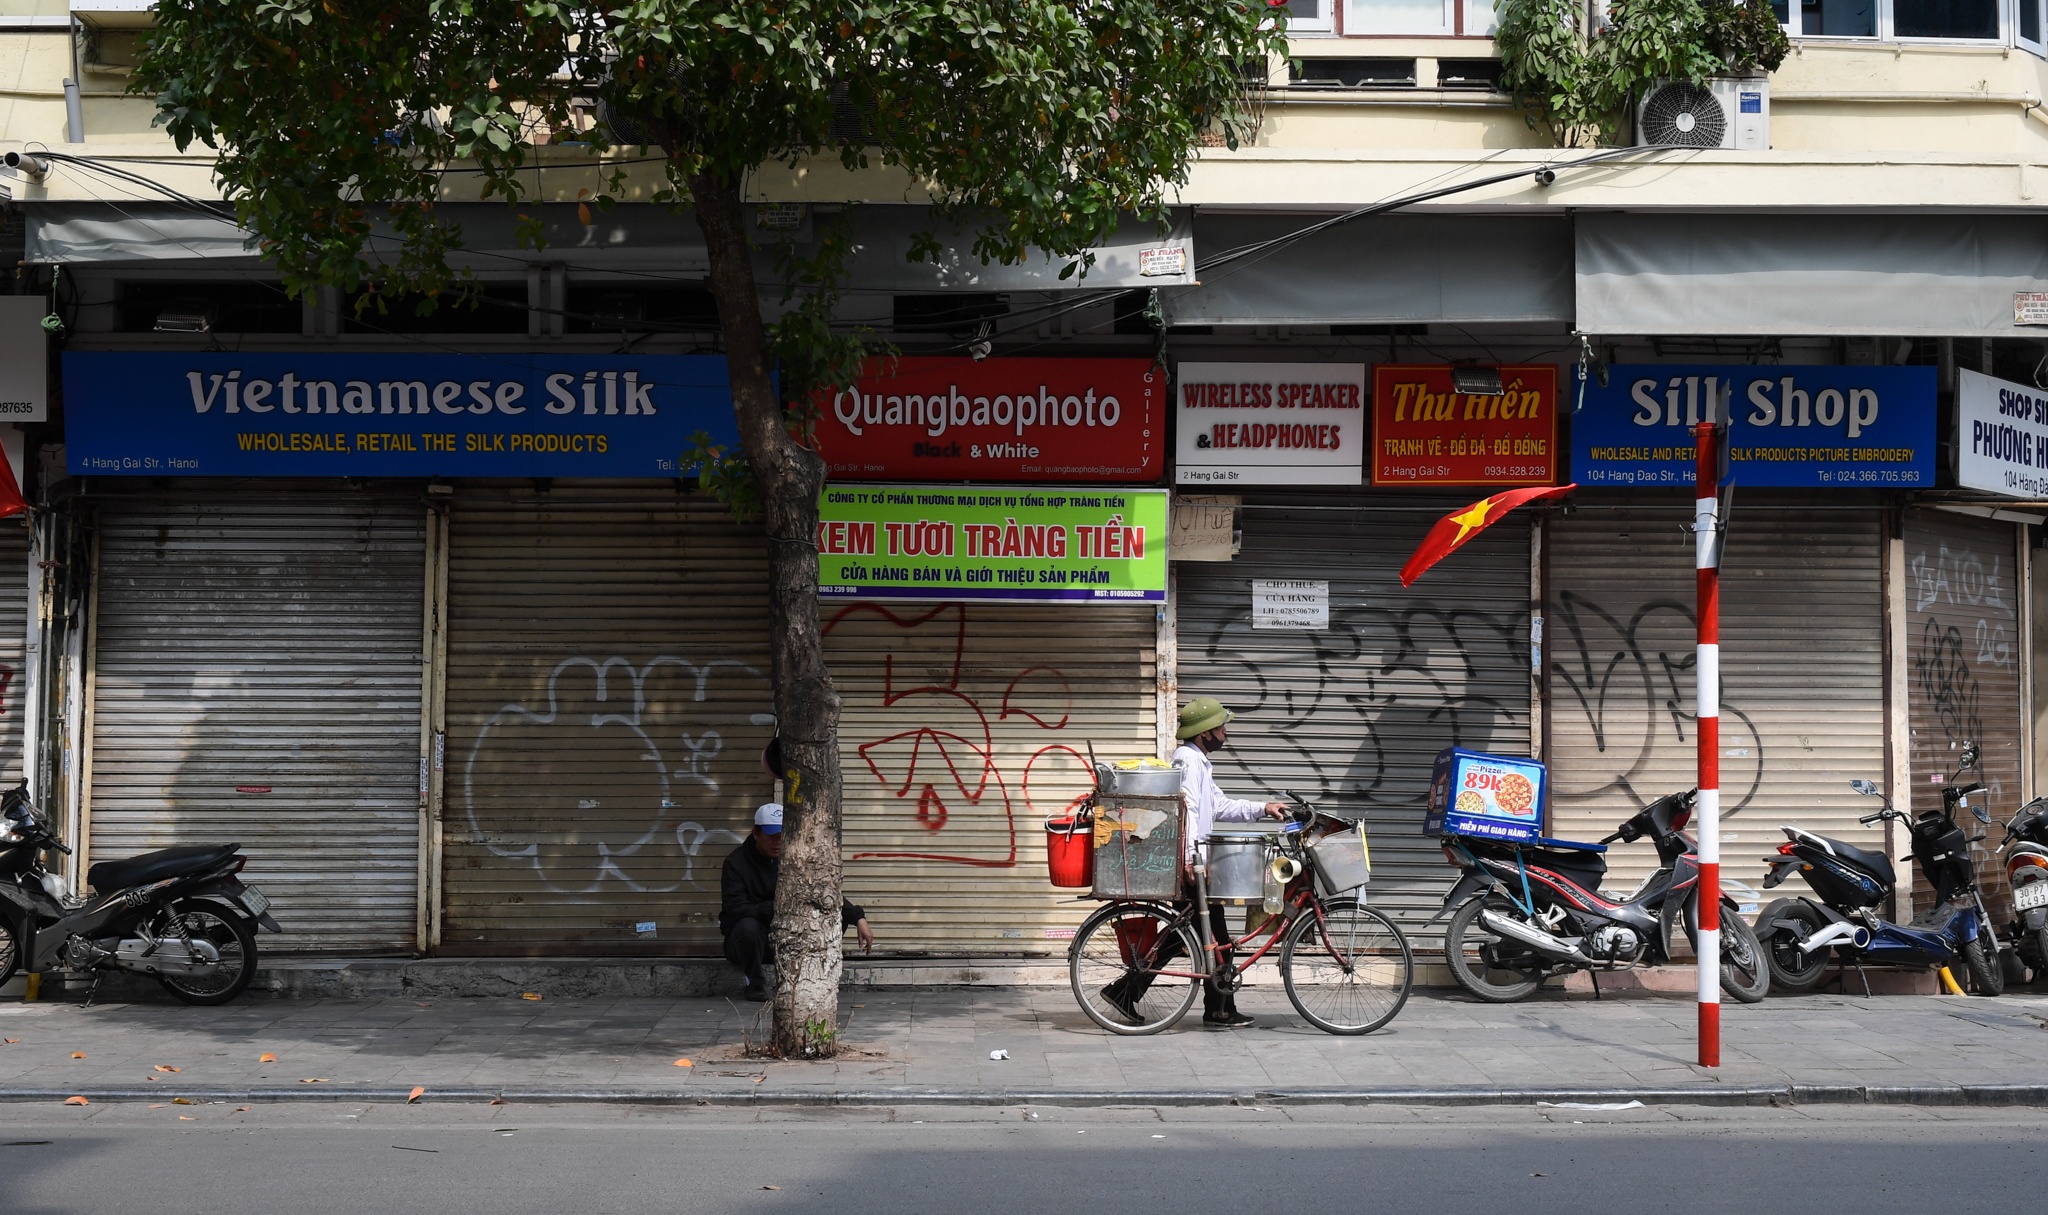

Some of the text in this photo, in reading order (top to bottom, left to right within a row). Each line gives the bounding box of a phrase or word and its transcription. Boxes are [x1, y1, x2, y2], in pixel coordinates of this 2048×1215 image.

[186, 371, 656, 415] Vietnamese Silk
[1184, 383, 1360, 409] WIRELESS SPEAKER
[1393, 377, 1540, 422] Thu Hiền
[0, 402, 33, 414] 87635
[834, 385, 1120, 436] Quangbaophoto
[1748, 377, 1880, 437] Shop
[1999, 388, 2031, 420] SHOP
[1142, 372, 1154, 467] Gallery
[238, 432, 608, 454] WHOLESALE, RETAIL THE SILK PRODUCTS
[1197, 424, 1341, 449] & HEADPHONES
[1973, 419, 2031, 466] PHƯƠNG
[914, 441, 1040, 459] Black & White
[1384, 439, 1424, 456] TRANH
[1591, 447, 1914, 462] WHOLESALE AND RETA SILK PRODUCTS PICTURE EMBROIDERY
[83, 457, 88, 467] 4
[92, 457, 120, 470] Hang
[123, 457, 141, 468] Gai
[168, 459, 199, 469] Hanoi
[656, 459, 675, 470] Tel:
[834, 463, 847, 472] Gai
[864, 463, 885, 472] Hanoi
[1022, 464, 1142, 475] Email: quangbaophoto@gmail.com
[1484, 466, 1546, 476] 0934.528.239
[1184, 471, 1240, 482] 2 Hang Gai Str
[1384, 466, 1450, 478] 2 Hang Gai Str
[1588, 470, 1604, 480] 104
[1608, 470, 1634, 483] Hang
[1818, 470, 1919, 482] Tel: 024.366.705.963
[2004, 470, 2017, 488] 104
[2019, 473, 2037, 497] Hàng
[828, 492, 854, 503] CÔNG
[858, 494, 868, 503] TY
[917, 495, 954, 505] THƯƠNG
[958, 496, 976, 507] MẠI
[979, 497, 1001, 507] DỊCH
[1005, 497, 1016, 508] VỤ
[1048, 497, 1066, 509] HỢP
[1069, 496, 1100, 507] TRÀNG
[885, 520, 954, 558] TƯƠI
[963, 517, 1066, 559] TRÀNG
[1075, 513, 1145, 560] TIỀN
[841, 562, 1109, 585] CỬA HÀNG BÁN VÀ GIỚI THIỆU SẢN PHẨM
[1288, 594, 1315, 602] HÀNG
[1480, 766, 1502, 774] Pizza
[1465, 772, 1502, 791] 89k
[1459, 821, 1527, 837] MIỄN PHÍ GIAO HÀNG
[126, 890, 149, 906] 806
[2019, 885, 2043, 898] 30-P7
[2020, 894, 2046, 908] 4493
